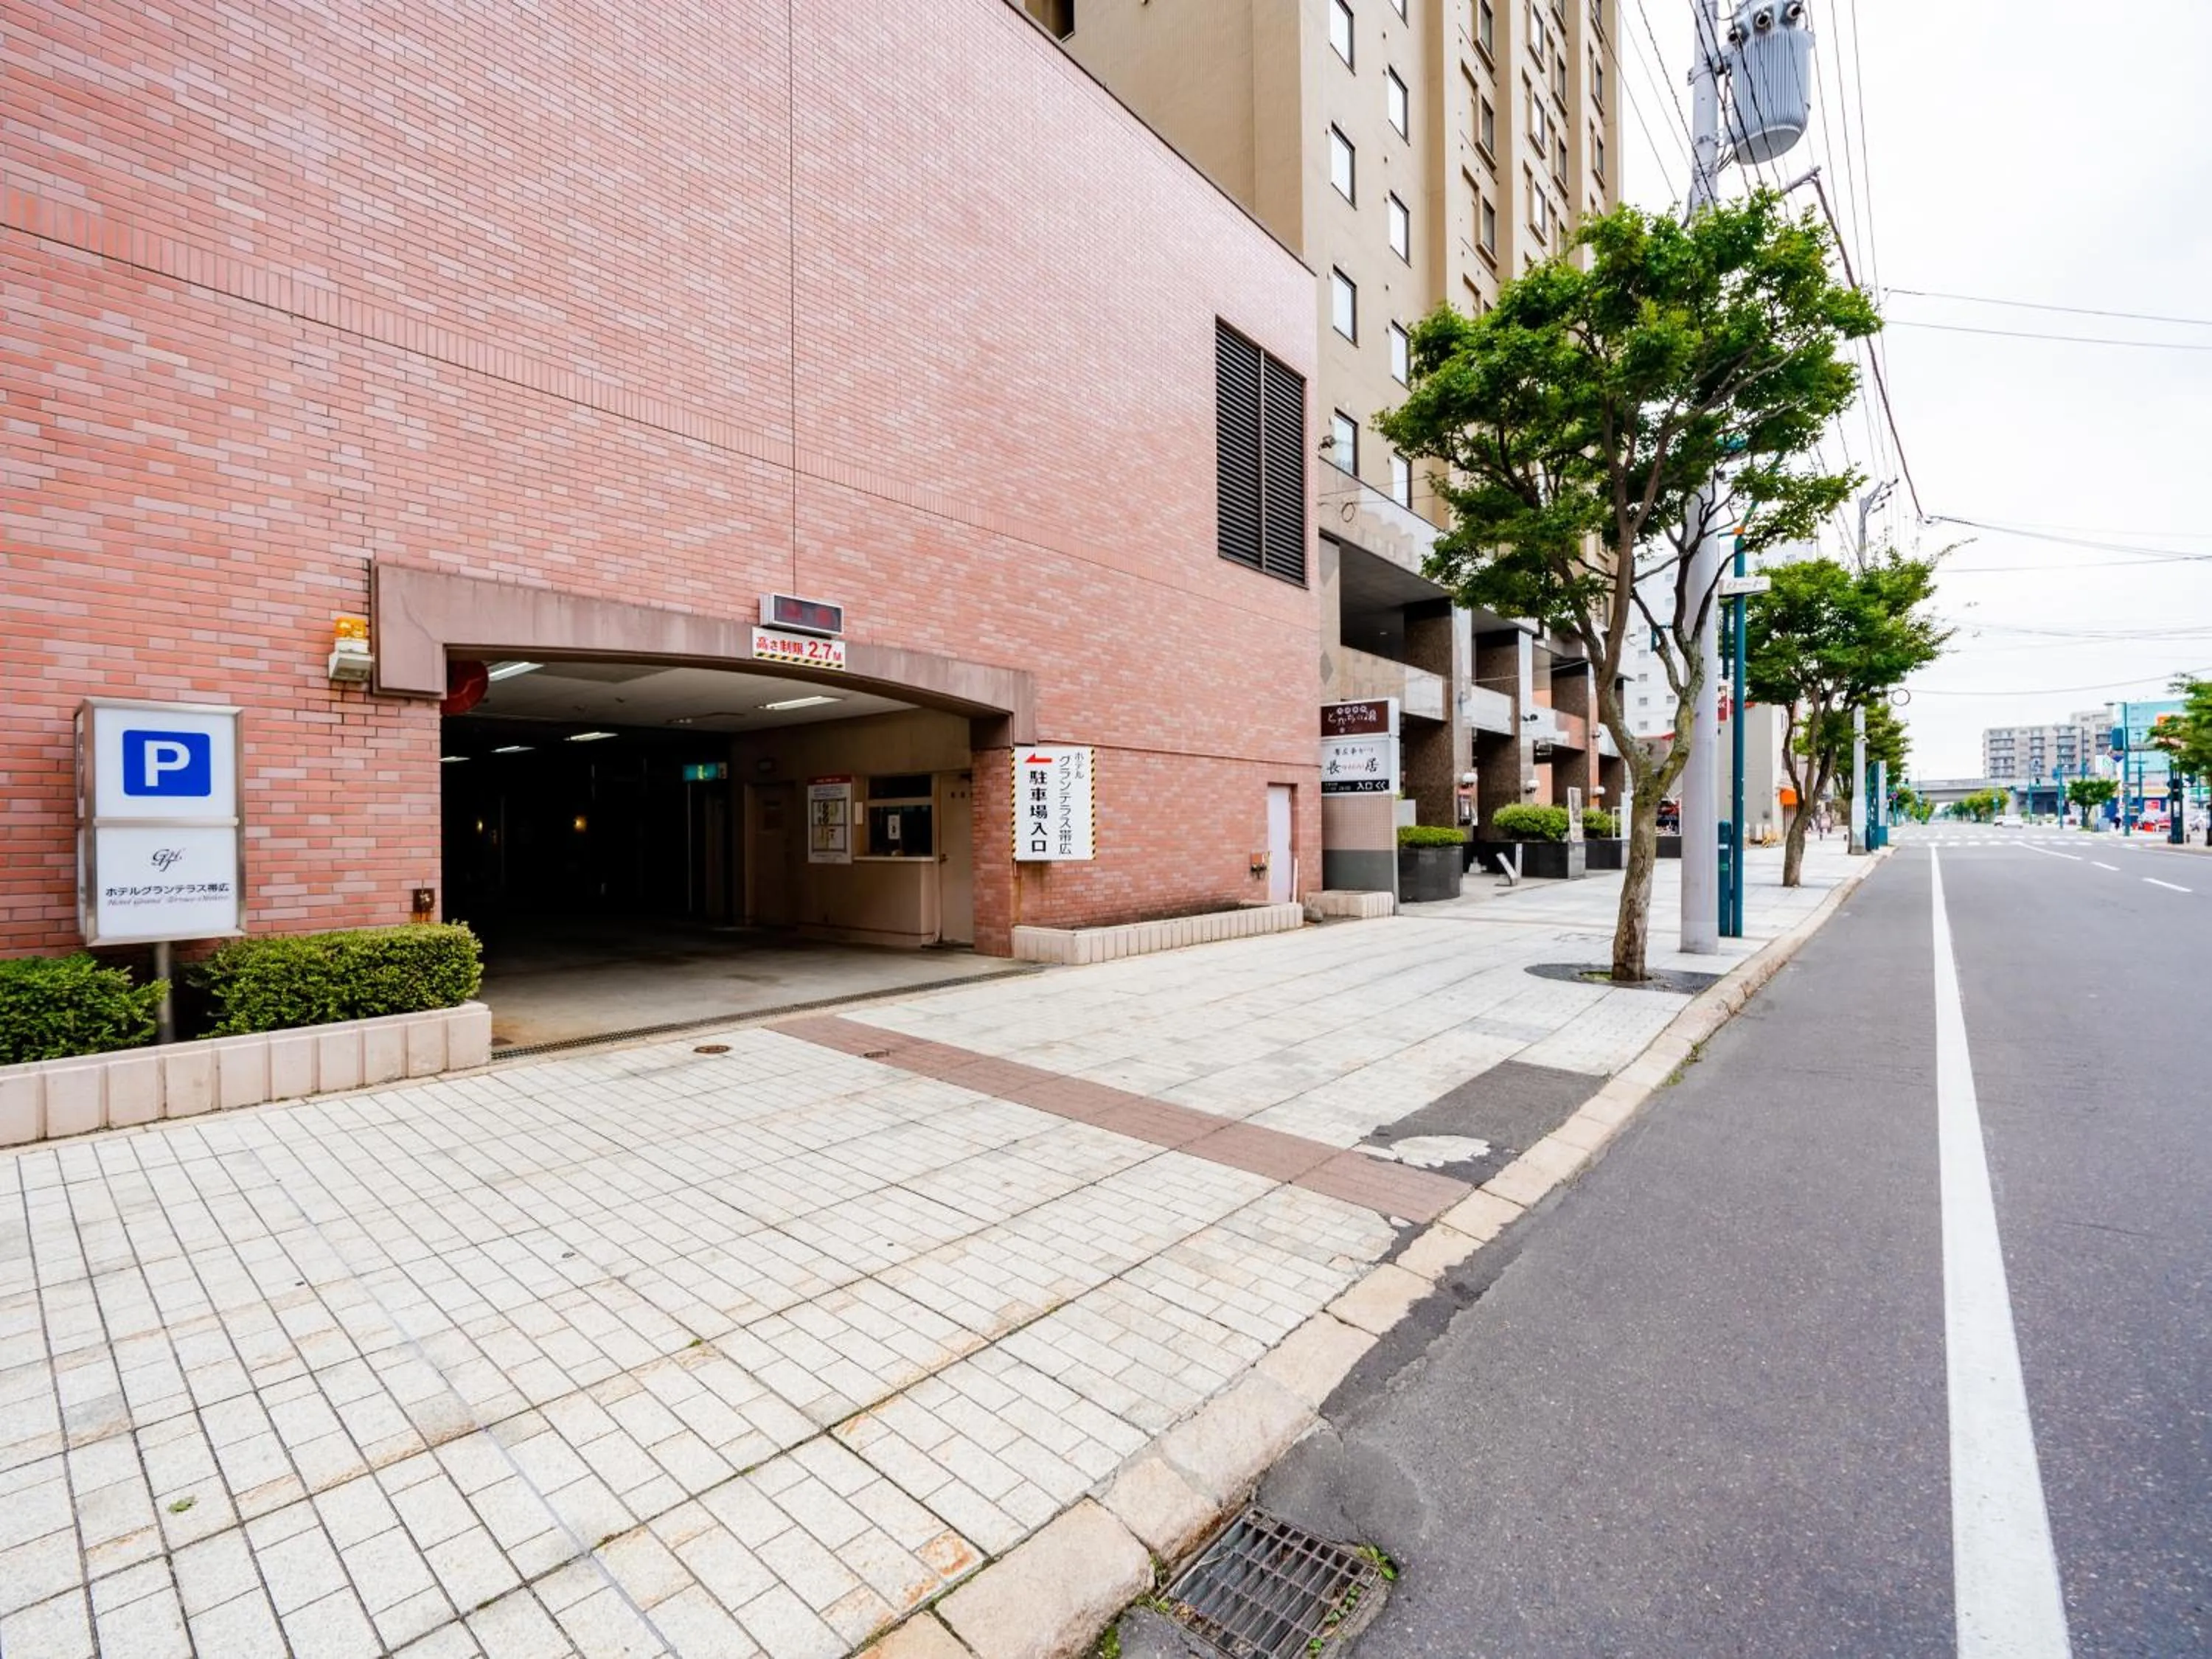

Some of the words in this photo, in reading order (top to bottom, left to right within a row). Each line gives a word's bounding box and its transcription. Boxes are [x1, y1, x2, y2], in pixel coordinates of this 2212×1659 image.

[145, 740, 189, 787] P
[1074, 752, 1084, 779] ホテル
[1029, 771, 1048, 852] 駐車場入口
[1060, 755, 1071, 855] グランテラス帯広
[105, 882, 230, 897] ホテルグランテラス帯広
